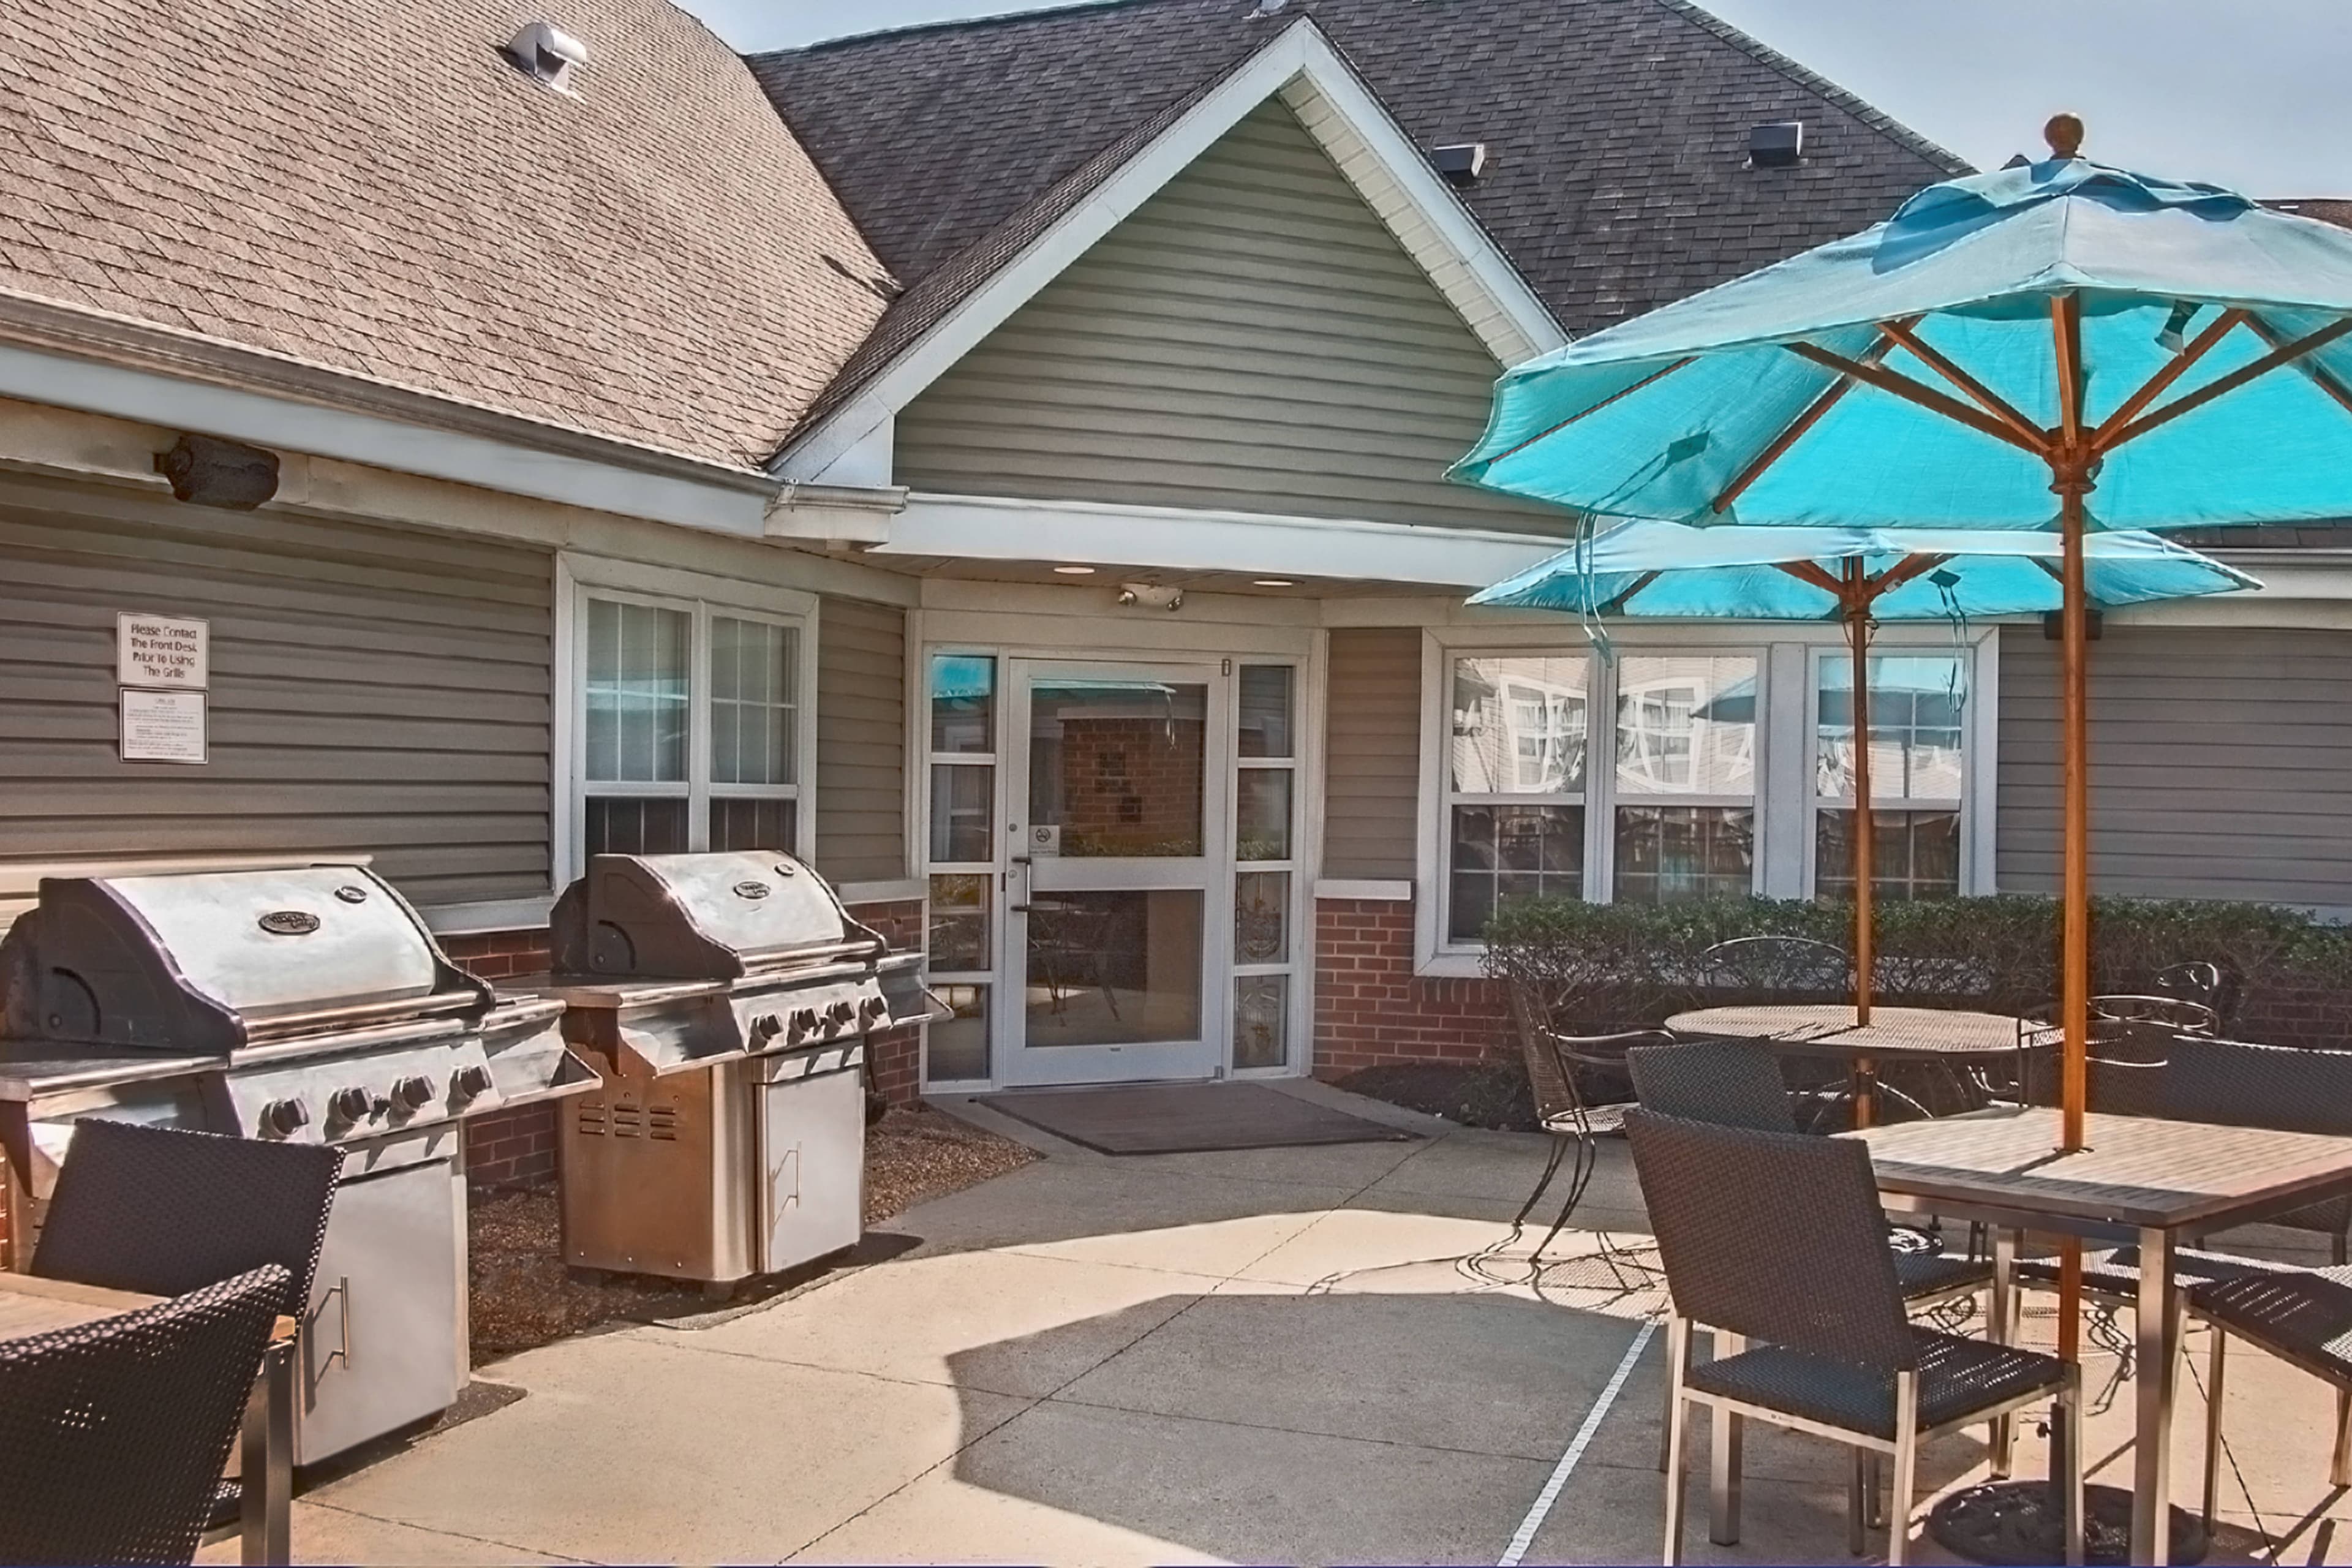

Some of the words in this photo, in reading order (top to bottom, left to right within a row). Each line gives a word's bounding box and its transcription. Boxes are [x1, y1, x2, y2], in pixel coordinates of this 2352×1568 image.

[164, 626, 197, 639] Contact
[130, 637, 147, 648] The
[150, 639, 173, 650] Front
[175, 641, 197, 652] Desk
[157, 654, 167, 663] To
[170, 654, 195, 667] Using
[143, 665, 160, 677] The
[163, 668, 185, 678] Grills
